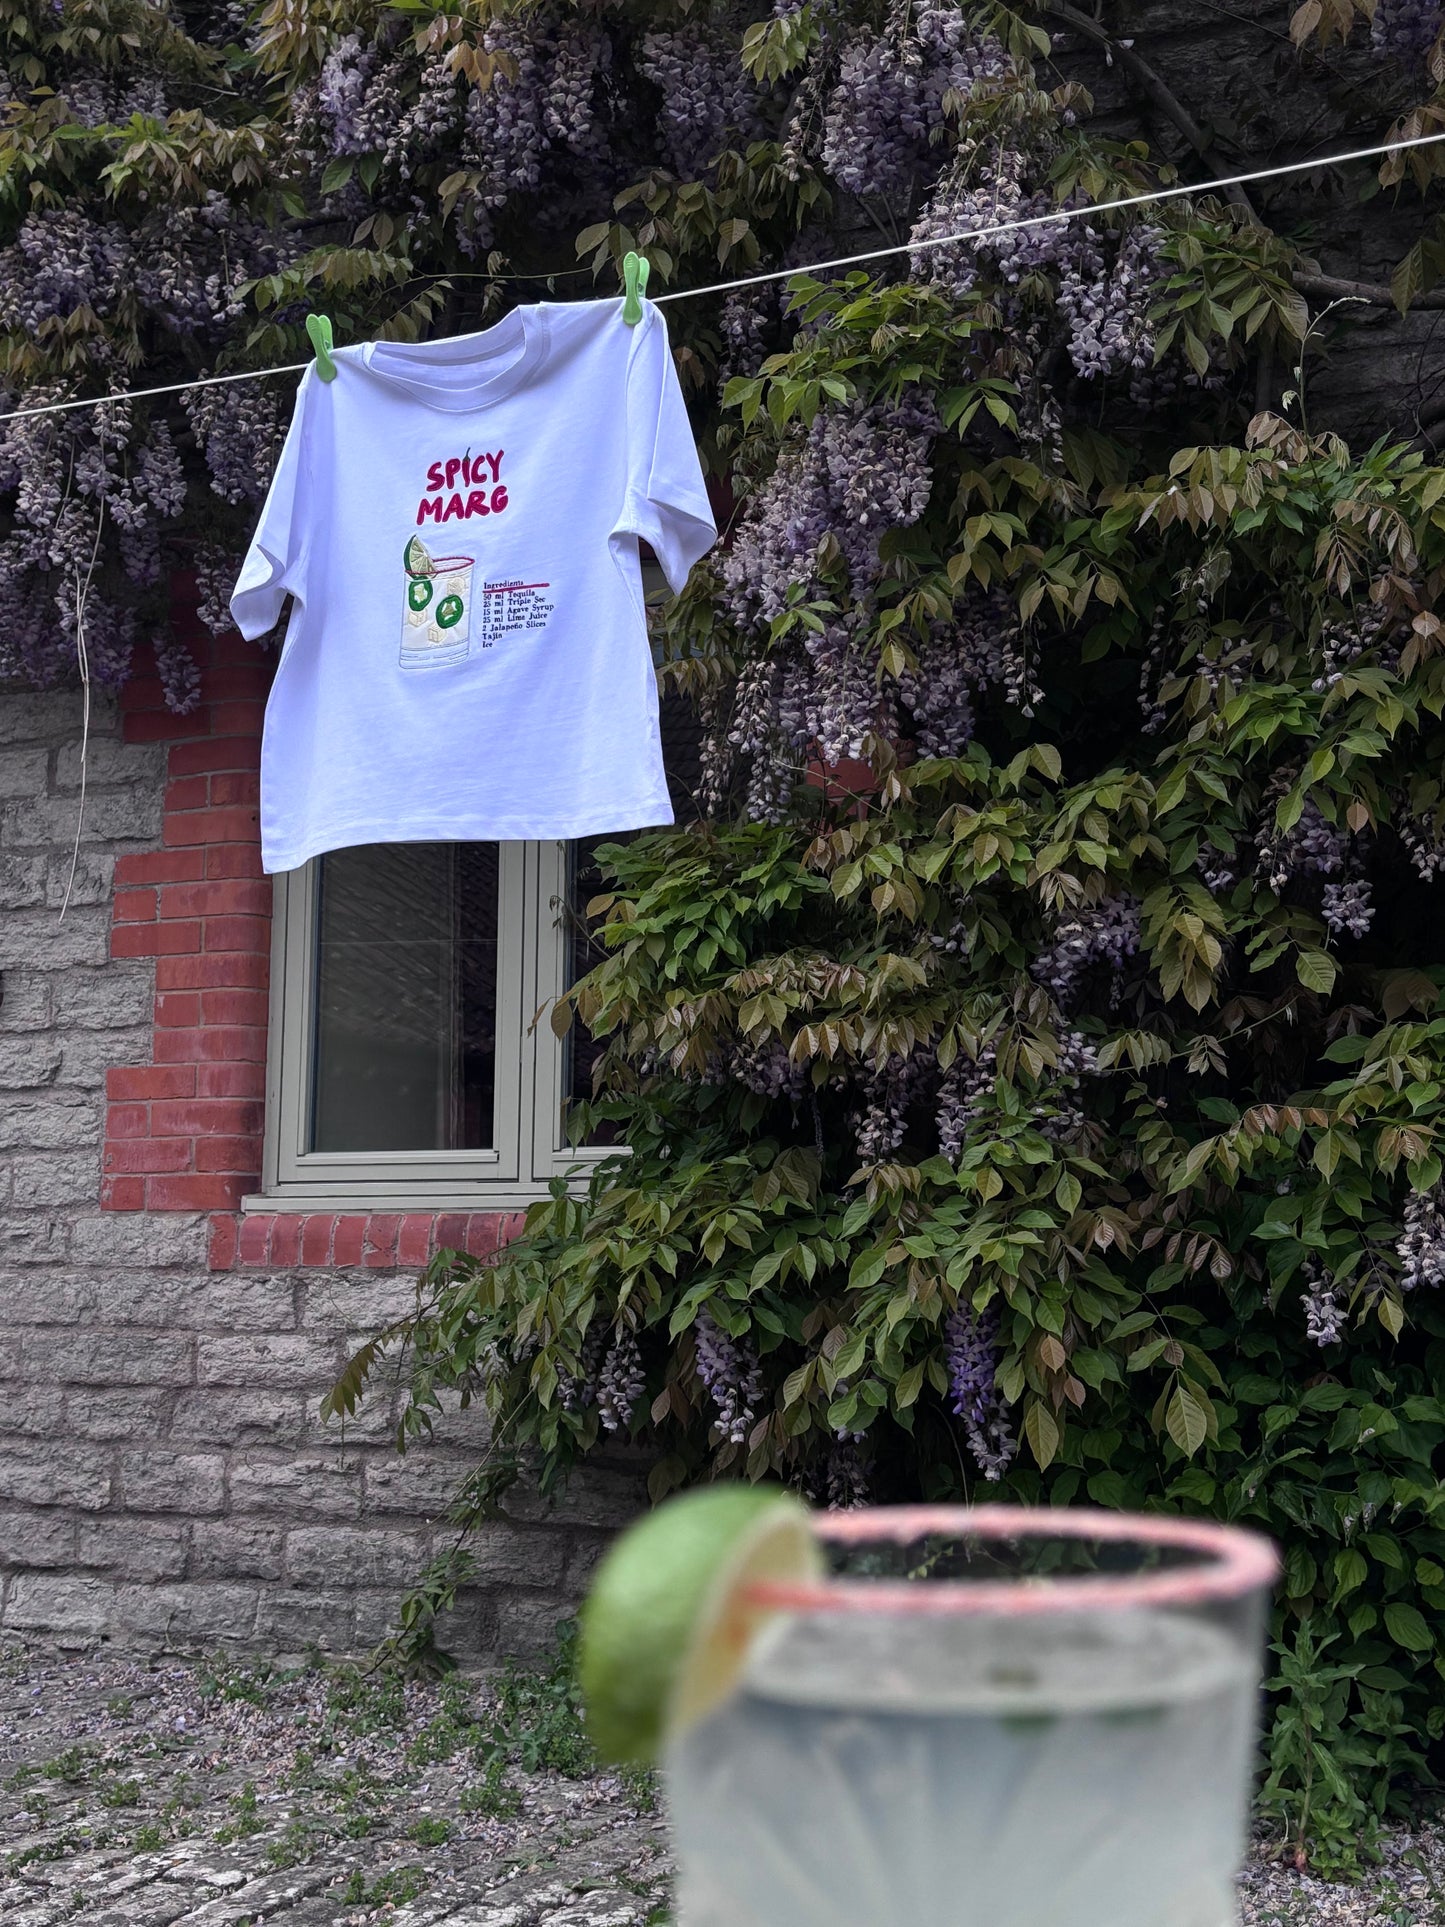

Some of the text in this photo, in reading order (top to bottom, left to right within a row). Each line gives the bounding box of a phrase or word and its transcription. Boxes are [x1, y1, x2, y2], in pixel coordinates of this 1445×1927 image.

[426, 447, 504, 492] SPICY
[416, 485, 509, 526] MARG
[484, 580, 523, 590] Ingredients
[508, 590, 535, 599] Tequila
[508, 598, 531, 606] Triple
[532, 604, 554, 612] Syrup
